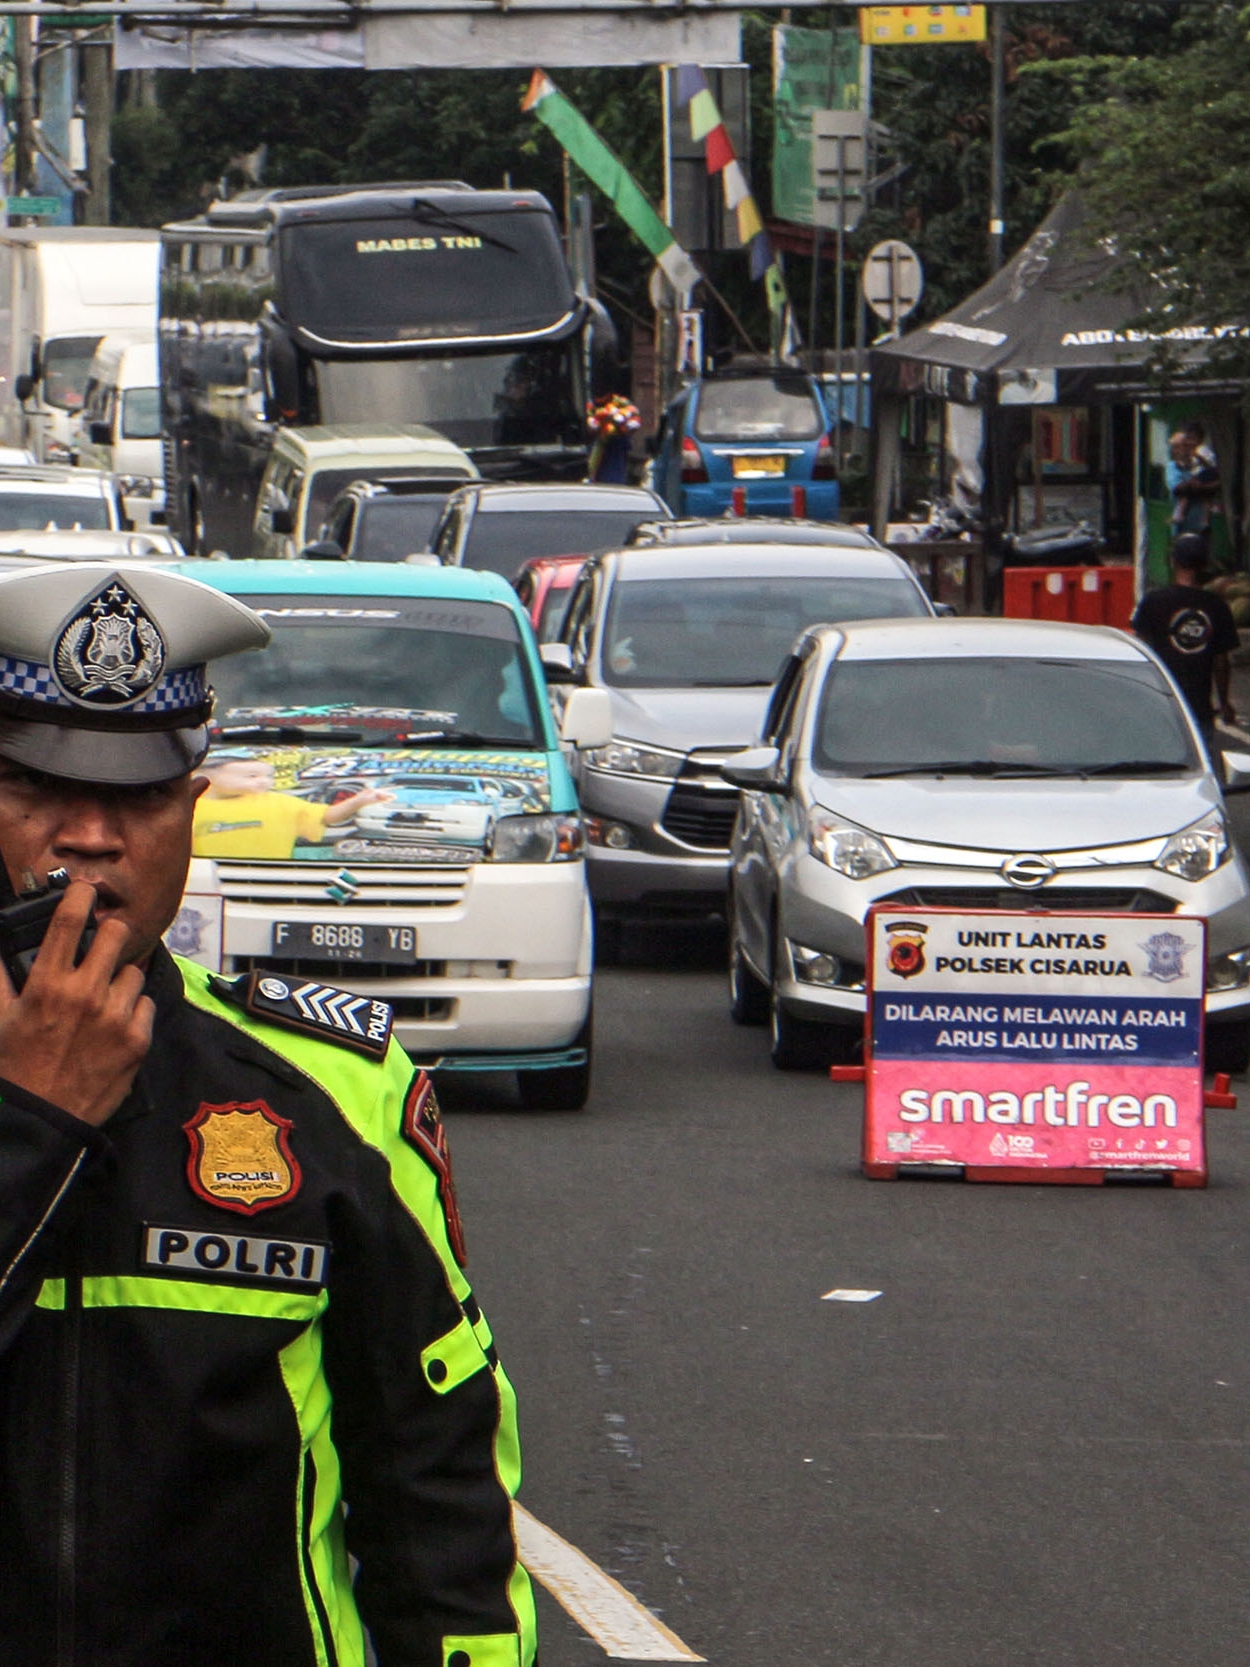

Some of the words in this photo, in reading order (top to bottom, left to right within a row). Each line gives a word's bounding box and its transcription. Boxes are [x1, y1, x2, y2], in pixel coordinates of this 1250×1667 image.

[356, 237, 438, 253] MABES
[441, 236, 482, 249] TNI
[276, 923, 289, 944] F
[311, 924, 364, 948] 8688
[388, 928, 413, 951] YB
[958, 931, 1011, 947] UNIT
[1016, 932, 1107, 949] LANTAS
[935, 956, 1025, 974] POLSEK
[1030, 958, 1132, 976] CISARUA
[366, 1001, 391, 1042] POLISI
[884, 1004, 997, 1022] DILARANG
[1003, 1007, 1116, 1025] MELAWAN
[1122, 1010, 1186, 1027] ARAH
[936, 1031, 997, 1047] ARUS
[1002, 1032, 1056, 1049] LALU
[1062, 1034, 1138, 1050] LINTAS
[899, 1080, 1177, 1128] smartfren
[216, 1172, 275, 1182] POLISI
[158, 1231, 315, 1280] POLRI
